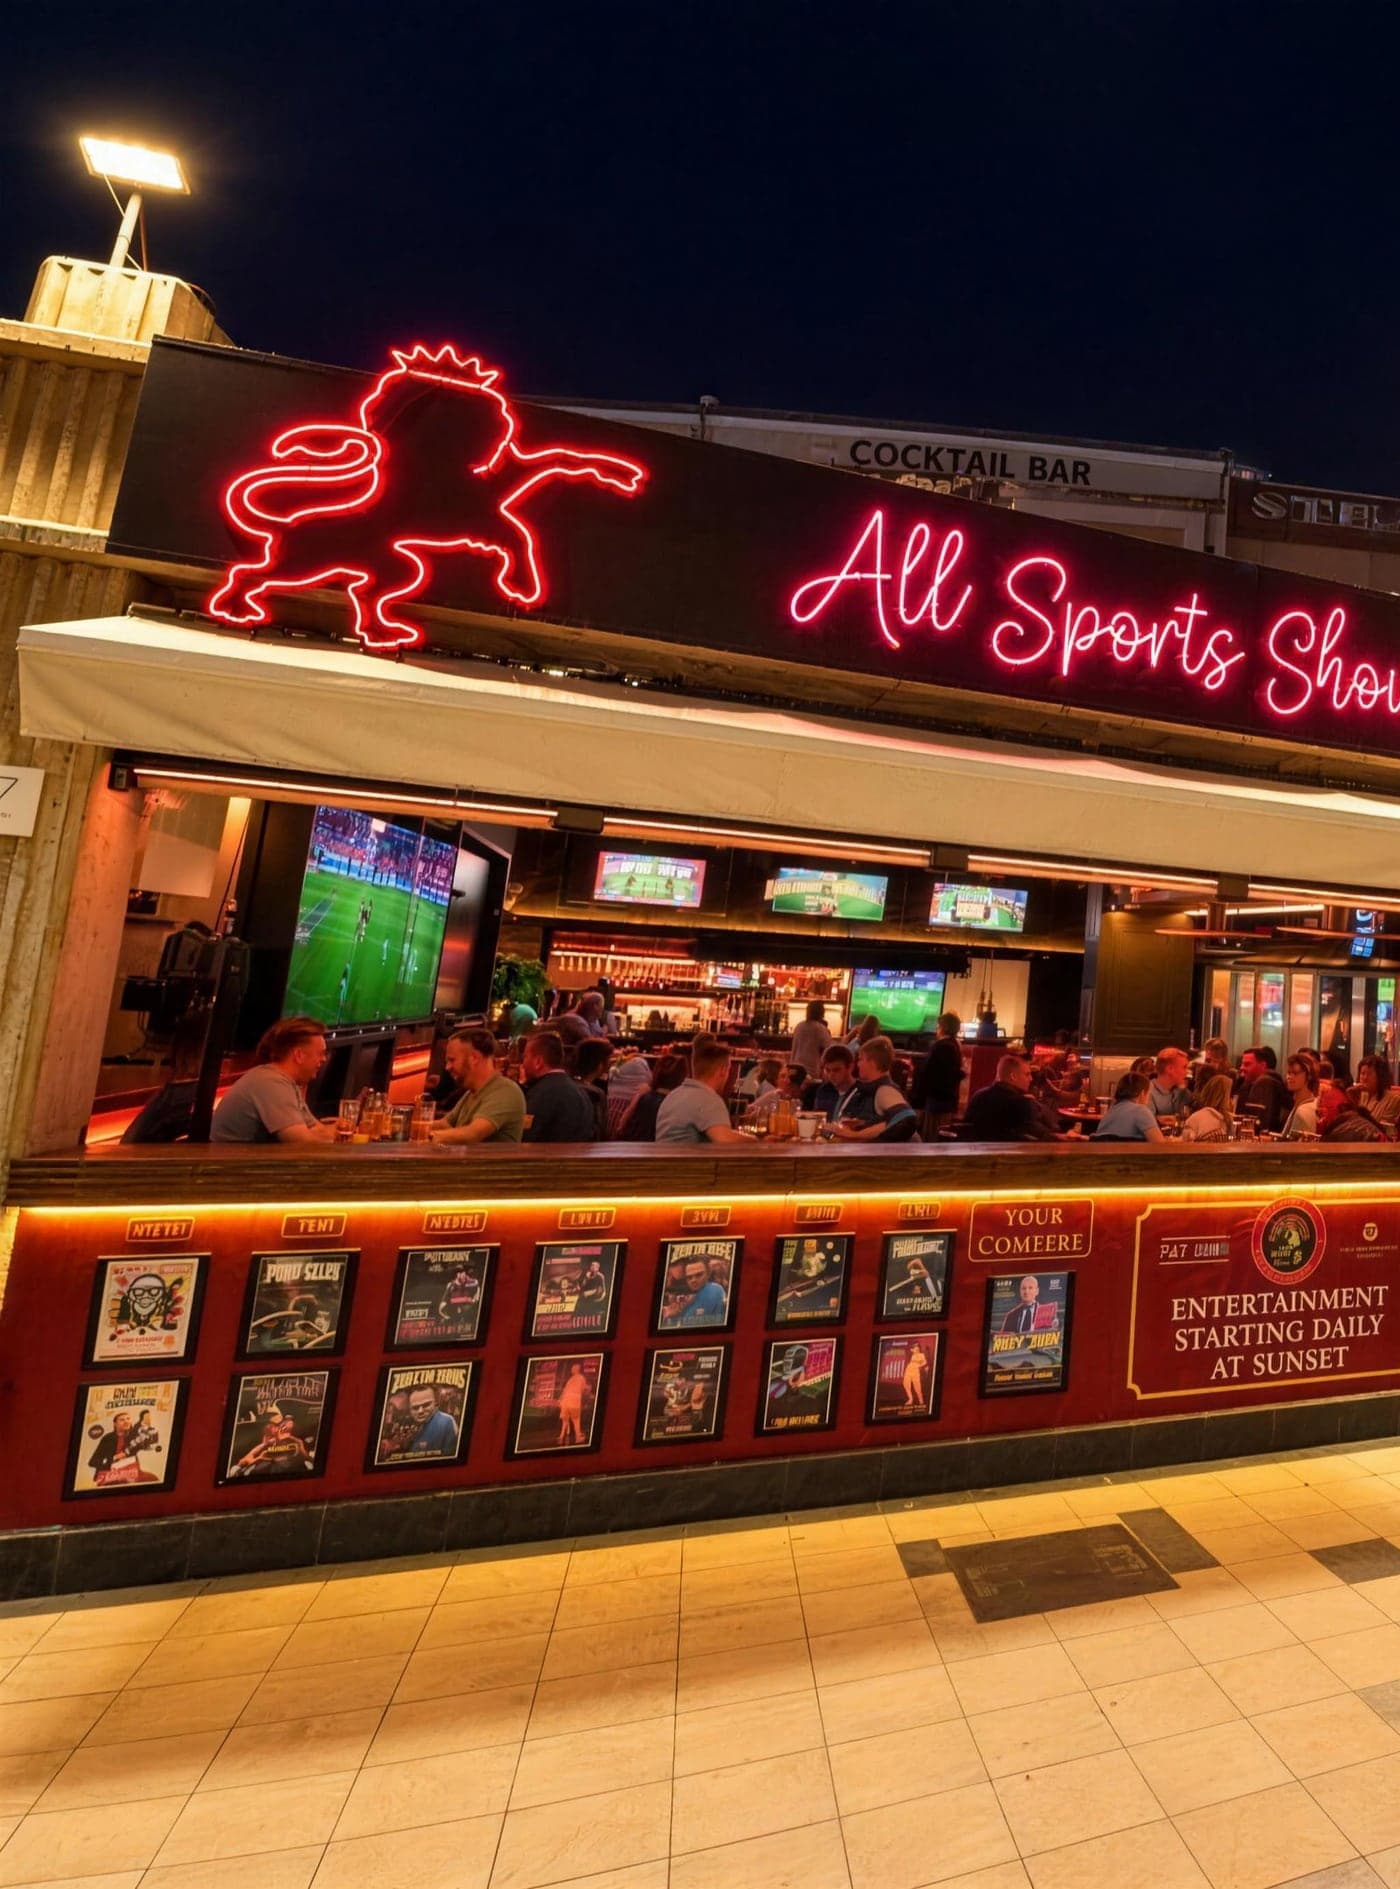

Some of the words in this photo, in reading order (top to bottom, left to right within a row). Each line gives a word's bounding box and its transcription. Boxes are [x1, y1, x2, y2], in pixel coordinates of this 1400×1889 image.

[850, 440, 1015, 479] COCKTAIL
[1029, 456, 1091, 486] BAR
[790, 510, 973, 650] All
[992, 557, 1245, 689] Sports
[1005, 1207, 1063, 1227] YOUR
[978, 1233, 1084, 1255] COMEERE
[1171, 1285, 1389, 1321] ENTERTAINMENT
[1174, 1320, 1305, 1352] STARTING
[1312, 1313, 1385, 1341] DAILY
[1209, 1355, 1245, 1380] AT
[1252, 1346, 1350, 1377] SUNSET
